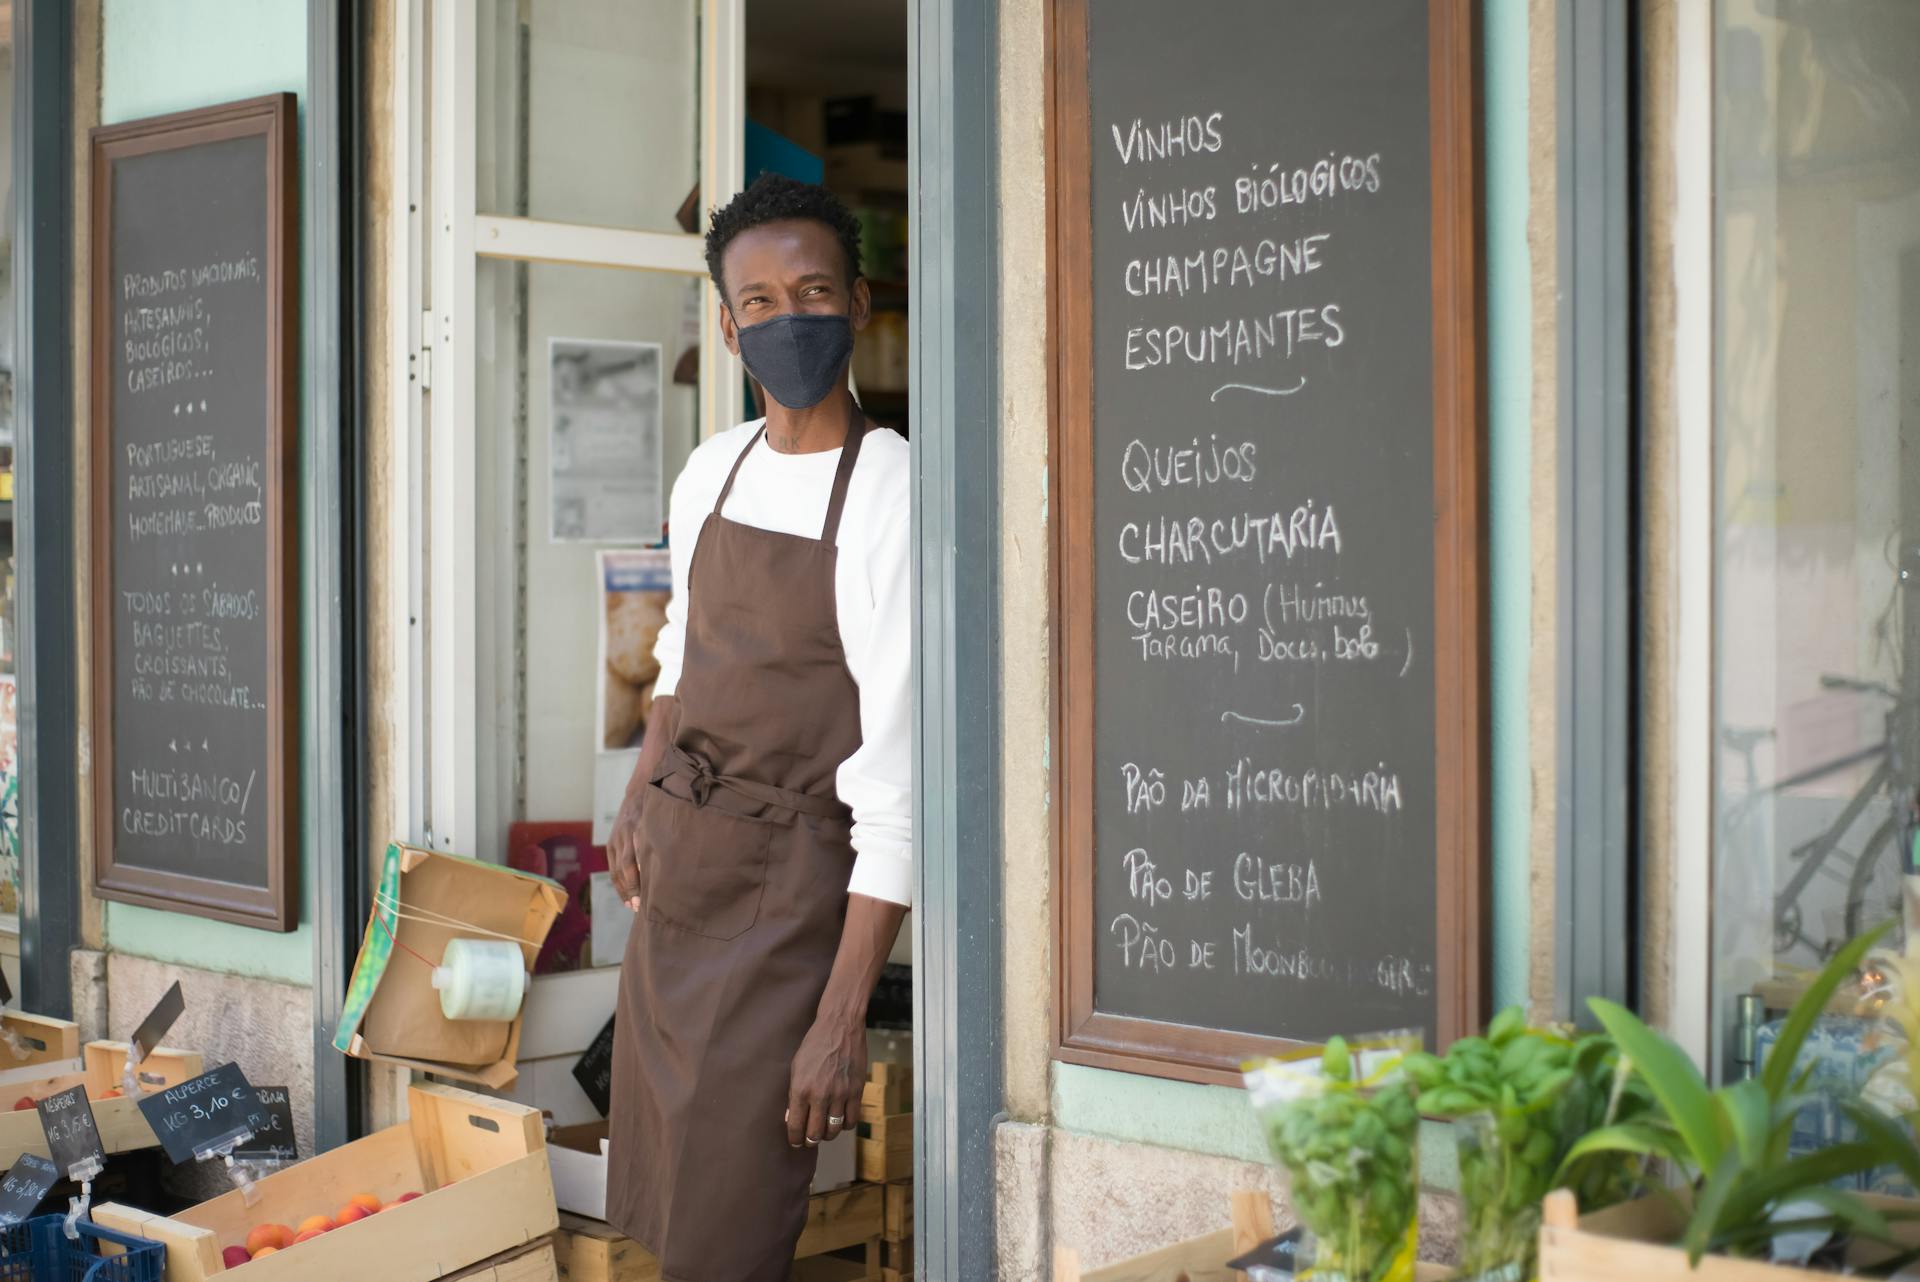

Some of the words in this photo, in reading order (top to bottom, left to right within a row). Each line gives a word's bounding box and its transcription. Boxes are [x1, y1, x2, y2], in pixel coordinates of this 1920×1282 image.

[1125, 233, 1331, 297] CHAMPAGNE
[1125, 304, 1344, 370] ESPUMANTES
[122, 591, 171, 615] TODOS
[160, 680, 175, 701] DE
[1181, 777, 1210, 812] DA
[1123, 847, 1172, 907] PÃO
[1183, 869, 1214, 900] DE
[1233, 852, 1322, 909] GLEBA
[1111, 913, 1175, 974] PÃO
[1188, 939, 1216, 969] DE
[164, 1073, 222, 1105] ALPERCE
[163, 1111, 188, 1132] KG
